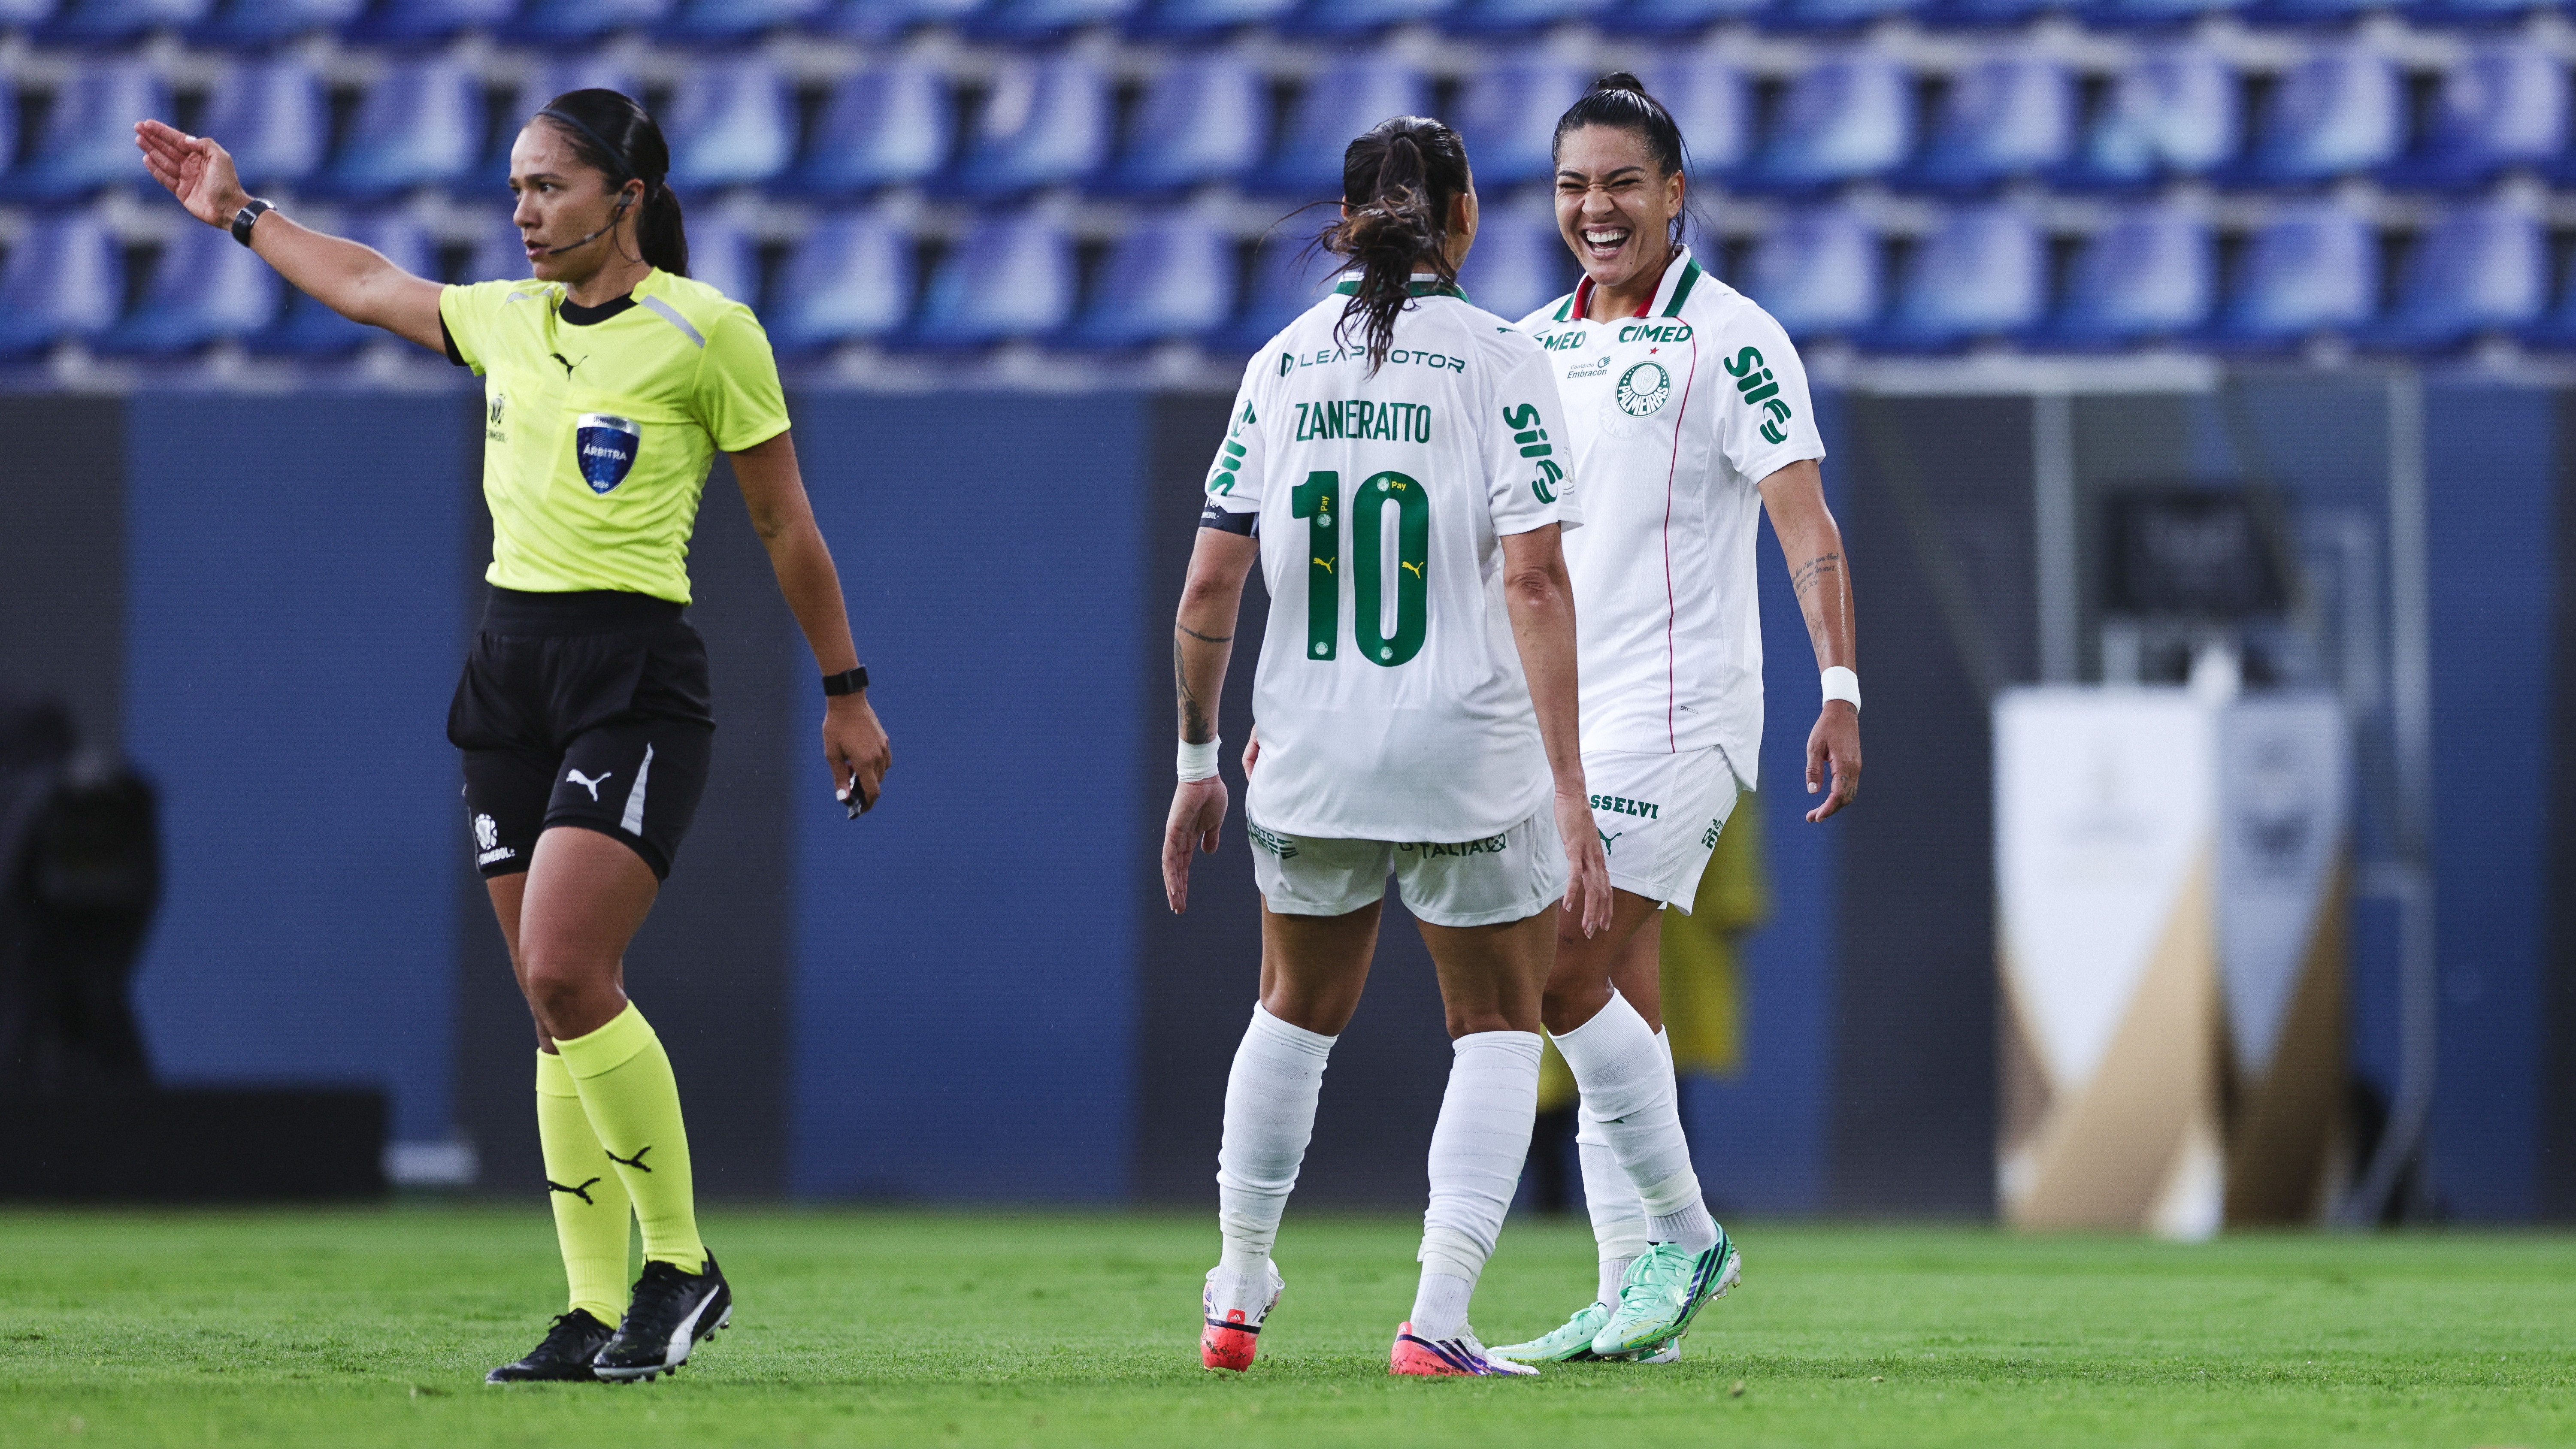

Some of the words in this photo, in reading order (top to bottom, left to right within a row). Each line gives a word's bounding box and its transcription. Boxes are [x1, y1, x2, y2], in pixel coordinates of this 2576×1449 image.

[1535, 331, 1586, 352] MED
[1619, 325, 1692, 343] CIMED
[1567, 369, 1607, 379] Embracon
[1618, 385, 1669, 416] PALMEIRAS
[1296, 400, 1431, 444] ZANERATTO
[583, 442, 627, 461] ÁRBITRA
[1392, 481, 1406, 491] Pay
[1320, 496, 1329, 511] Pay
[1292, 471, 1429, 667] 10
[1680, 705, 1700, 715] DRYCELL
[1590, 794, 1659, 820] SSELVI
